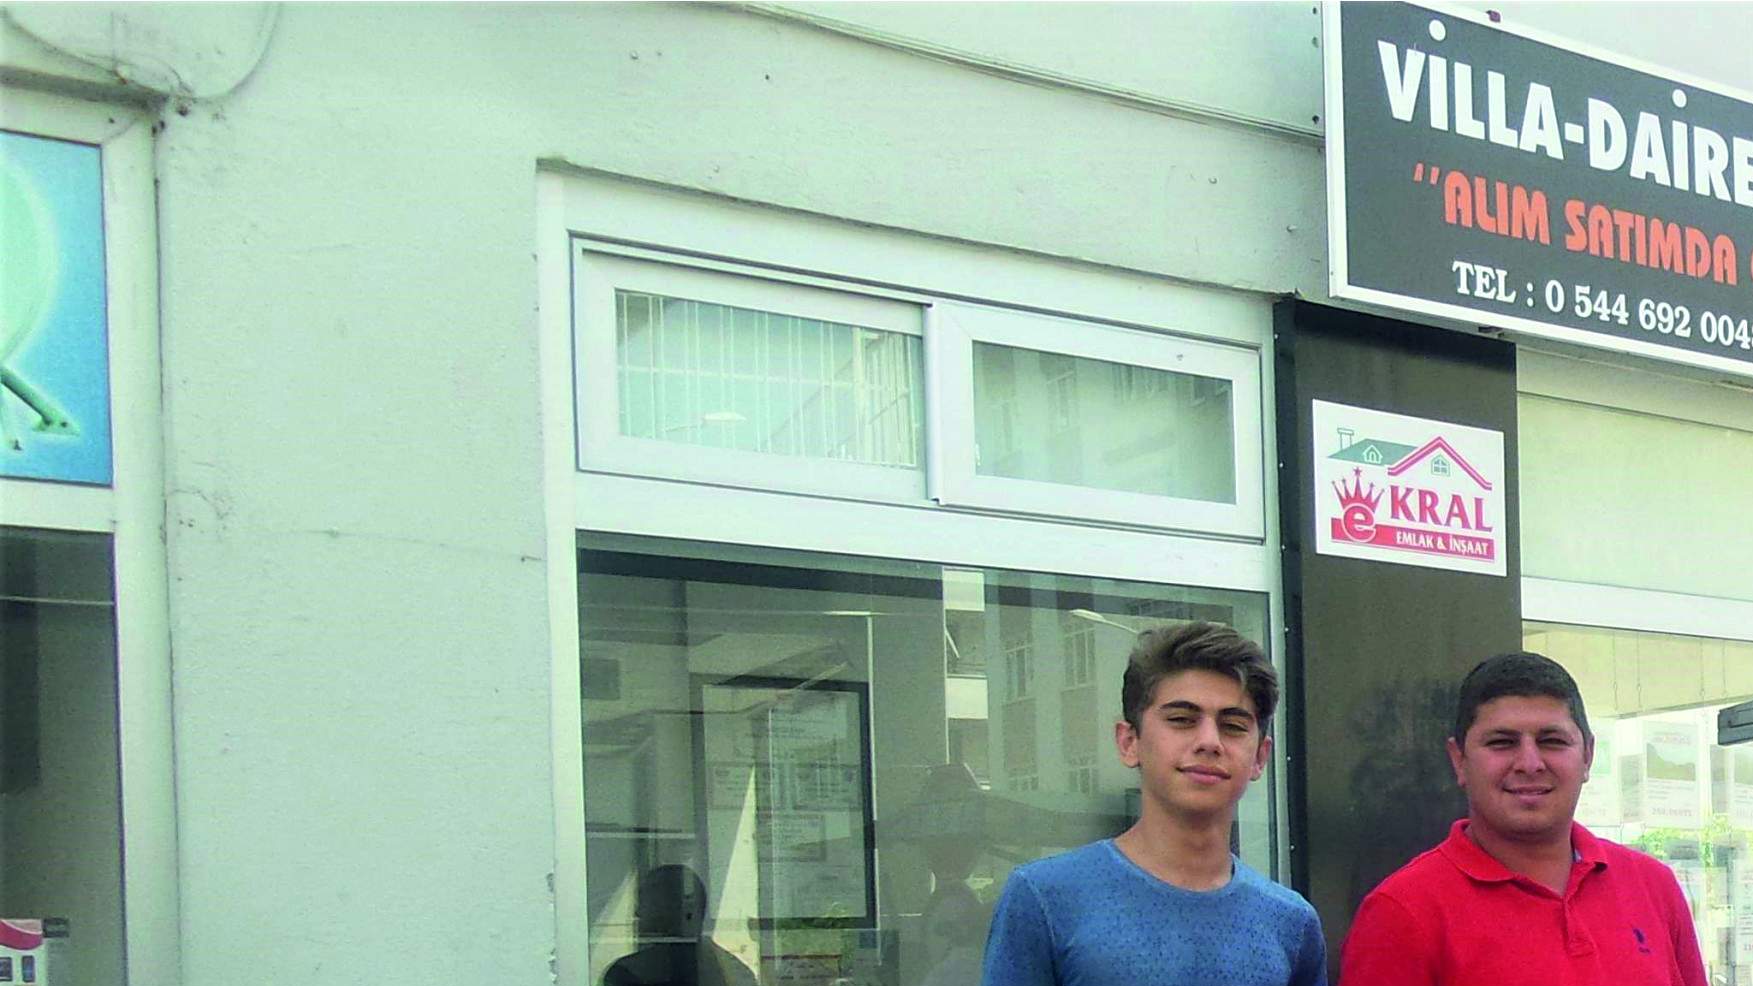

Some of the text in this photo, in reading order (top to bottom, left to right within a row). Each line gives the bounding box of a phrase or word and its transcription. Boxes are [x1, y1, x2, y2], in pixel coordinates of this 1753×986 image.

[1564, 200, 1738, 286] SATIMDA
[1452, 260, 1517, 303] TEL
[1545, 279, 1565, 313] 0
[1574, 284, 1629, 325] 544
[1638, 298, 1692, 338] 692
[1389, 484, 1494, 533] KRAL
[1396, 527, 1488, 557] EMLAK & İNŞAAT
